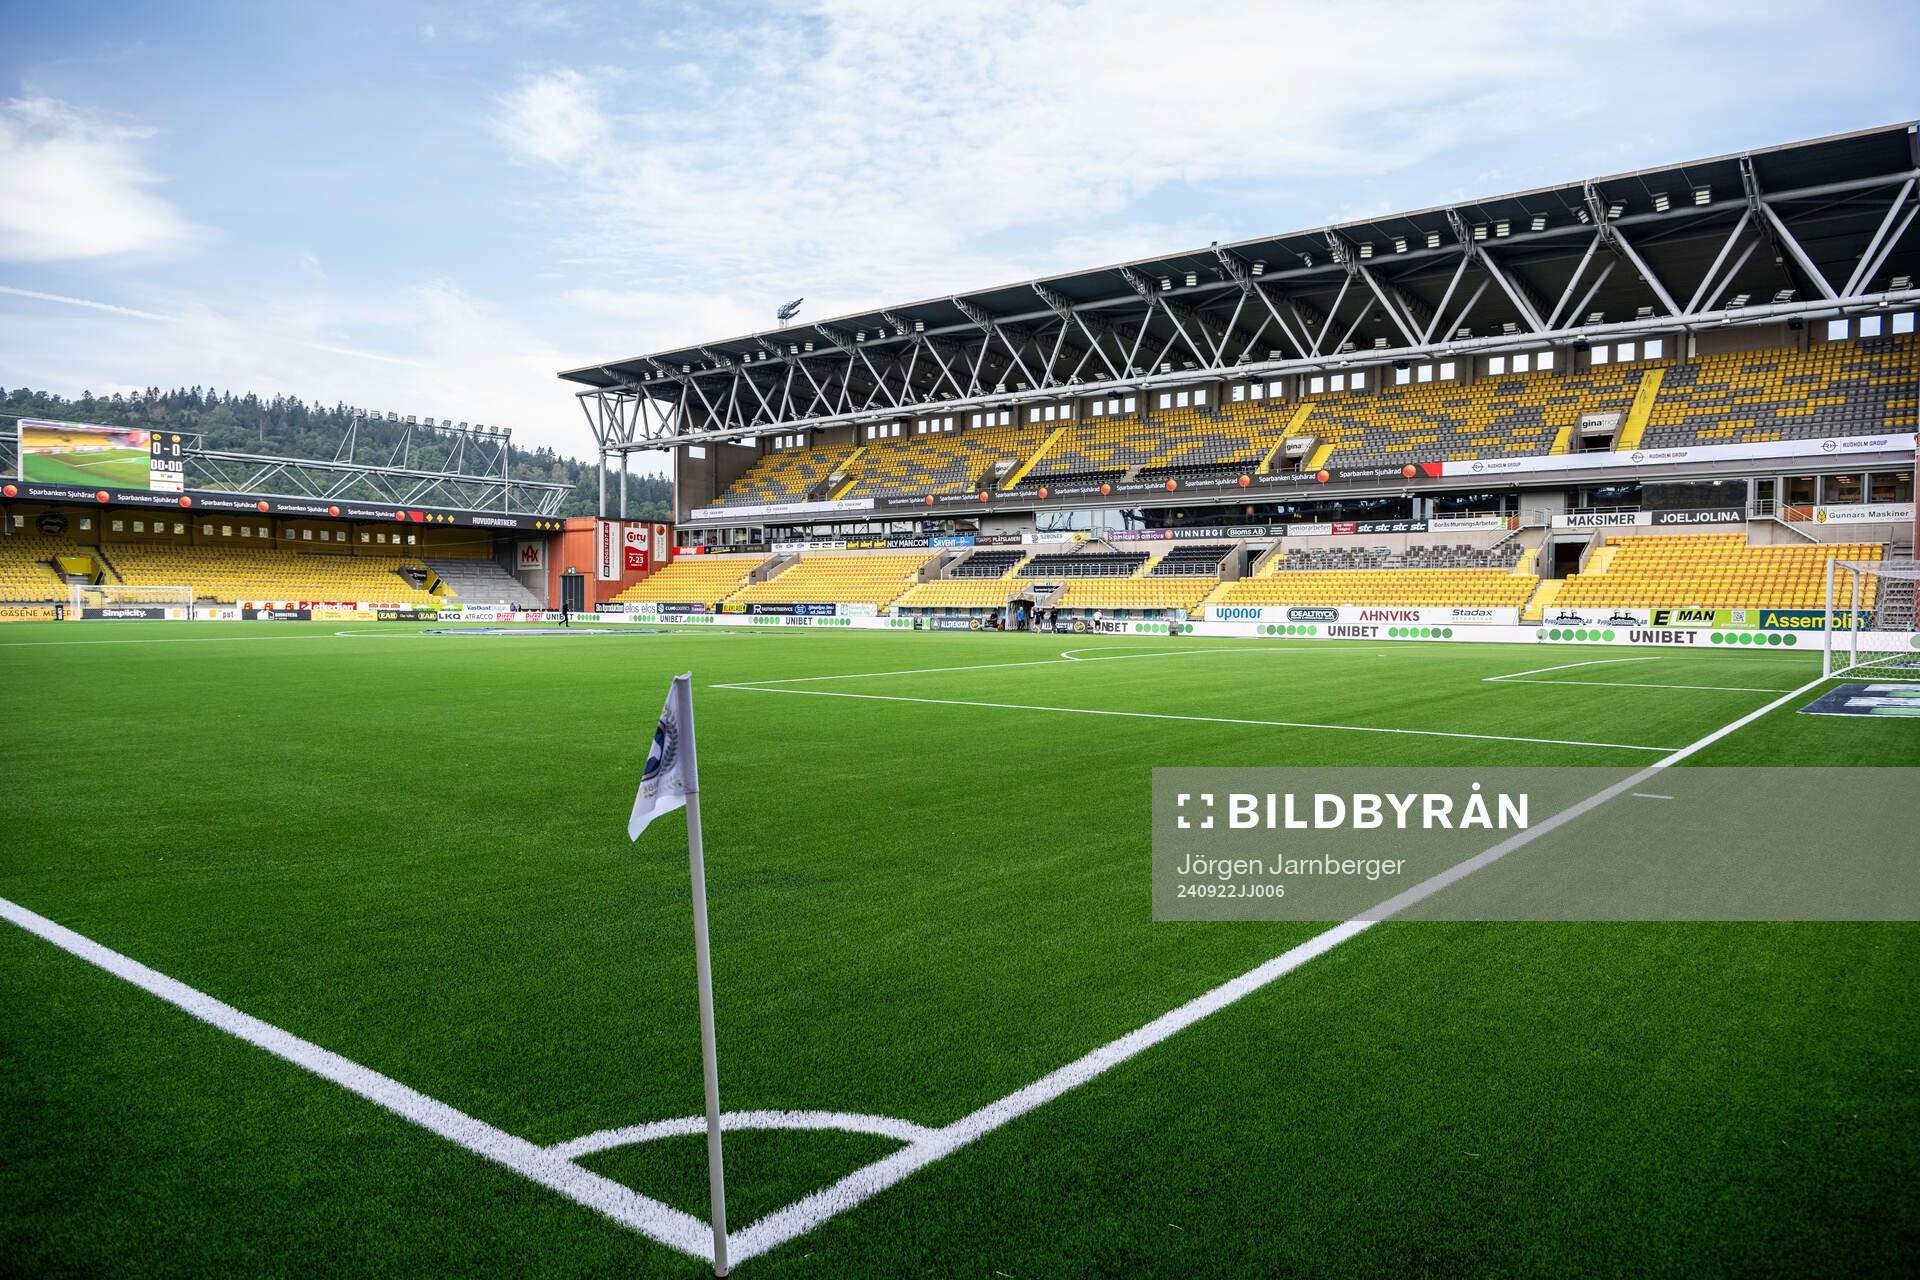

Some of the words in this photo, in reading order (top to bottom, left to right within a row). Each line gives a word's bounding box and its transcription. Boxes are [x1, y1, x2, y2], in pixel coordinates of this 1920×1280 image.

[153, 442, 161, 455] 0
[172, 443, 181, 456] 0
[1339, 470, 1374, 479] Sparbanken
[1185, 480, 1214, 488] Sparbanken
[1258, 475, 1291, 484] Sparbanken
[29, 488, 66, 497] Sparbanken
[118, 494, 152, 503] Sparbanken
[201, 499, 233, 508] Sparbanken
[277, 504, 307, 512] Sparbanken
[1660, 511, 1740, 524] JOELJOLINA
[1829, 511, 1865, 520] Gunnars
[1868, 510, 1909, 518] Maskiner
[472, 517, 517, 527] HUVUDPARTNERS
[1567, 513, 1636, 527] MAKSIMER
[1357, 523, 1373, 532] stc
[1375, 523, 1390, 531] stc
[1392, 522, 1408, 531] stc
[1410, 521, 1426, 530] stc
[1174, 529, 1223, 538] VINNERGI
[629, 556, 644, 564] 7-23
[545, 613, 574, 621] UNIBT
[1216, 608, 1263, 620] uponor
[1291, 610, 1334, 618] IDEALTRYCK
[1359, 610, 1420, 622] AHNVIKS
[660, 615, 683, 623] UNIBET
[785, 617, 813, 625] UNIBET
[1765, 613, 1865, 629] Assemblin
[1328, 625, 1379, 638] UNIBET
[1629, 630, 1697, 644] UNIBET
